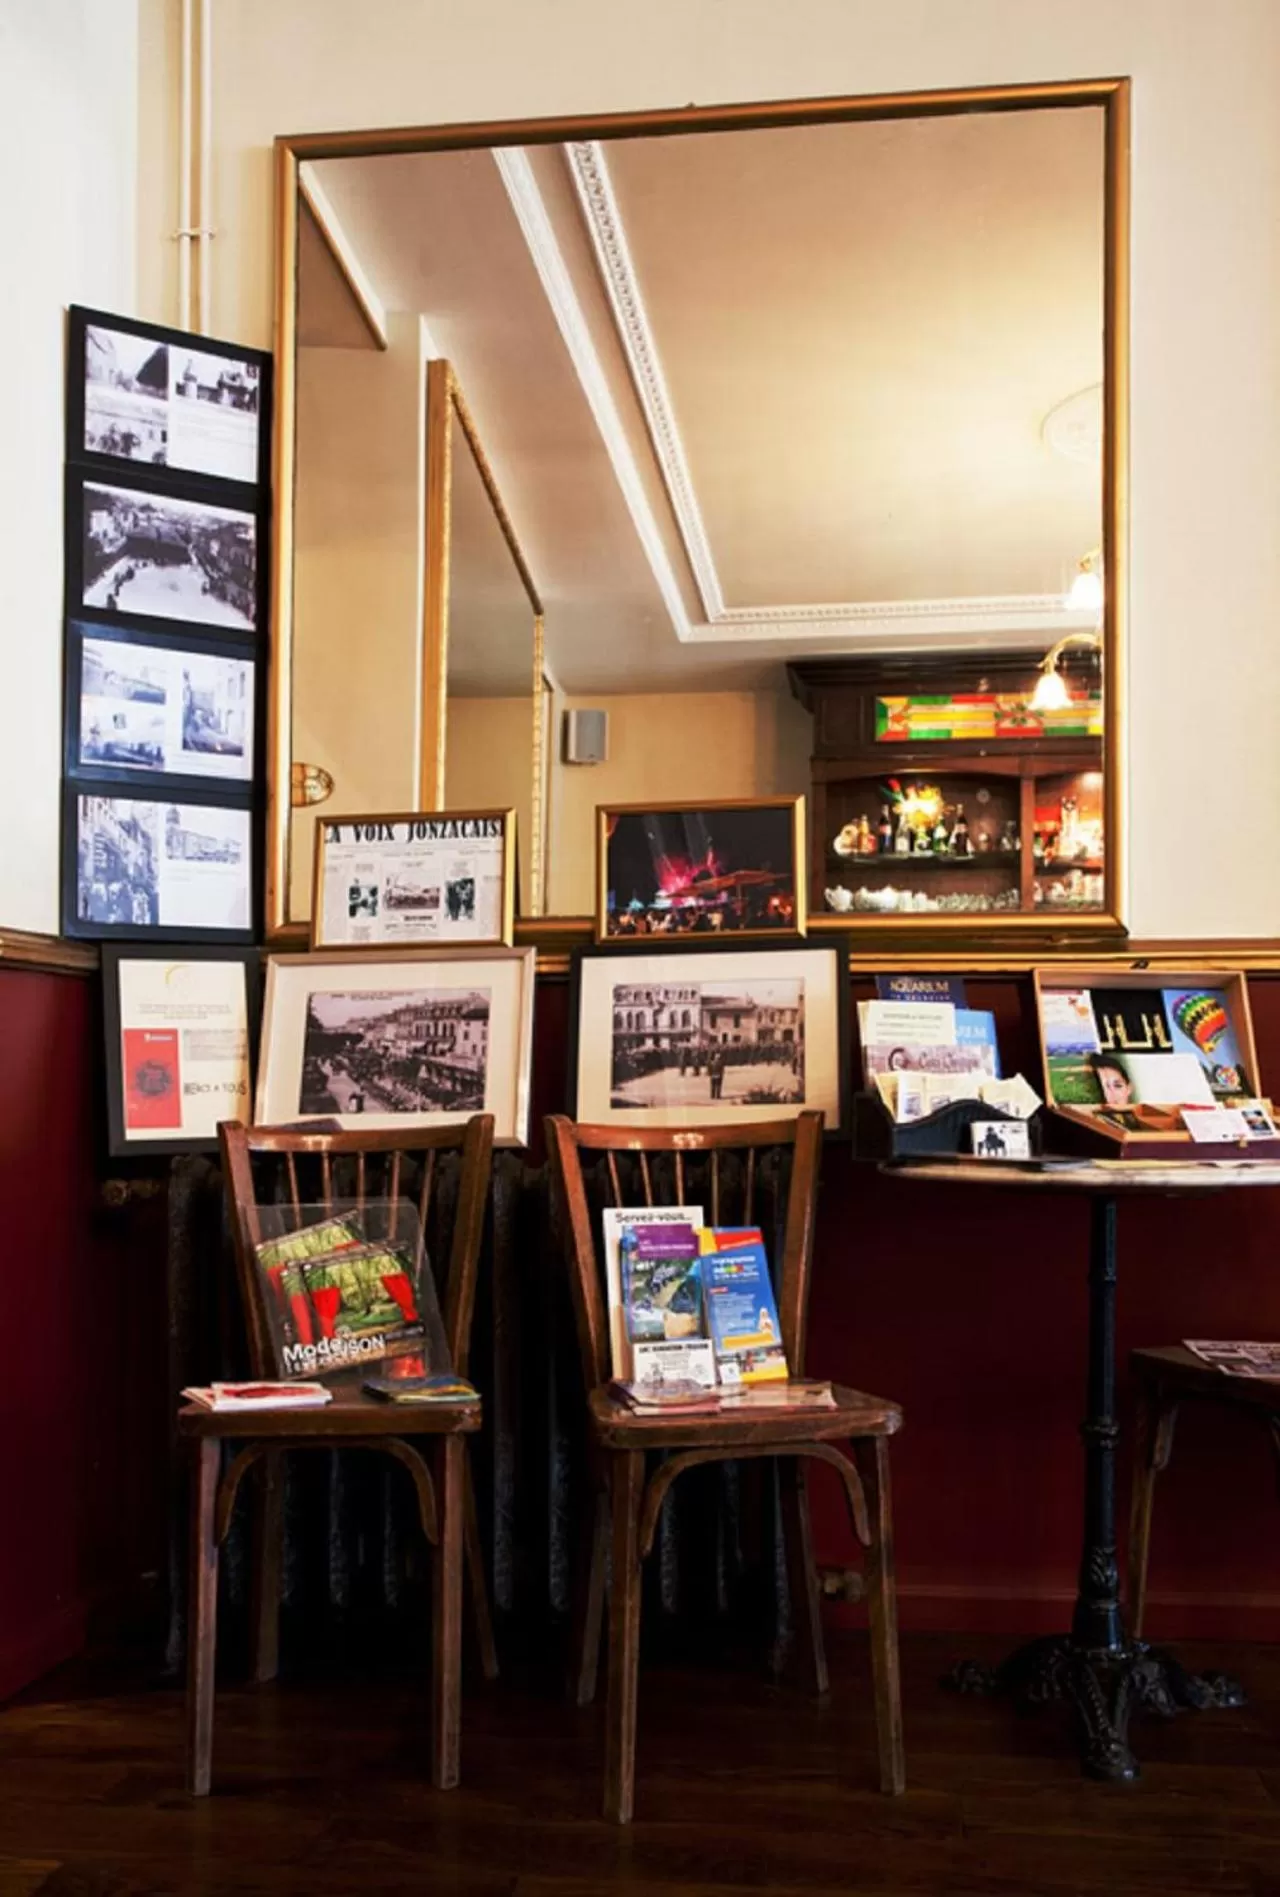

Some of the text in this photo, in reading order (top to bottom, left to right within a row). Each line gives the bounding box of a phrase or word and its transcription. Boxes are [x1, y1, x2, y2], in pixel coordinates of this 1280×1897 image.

[325, 820, 504, 843] A VOIX JONZACAIS
